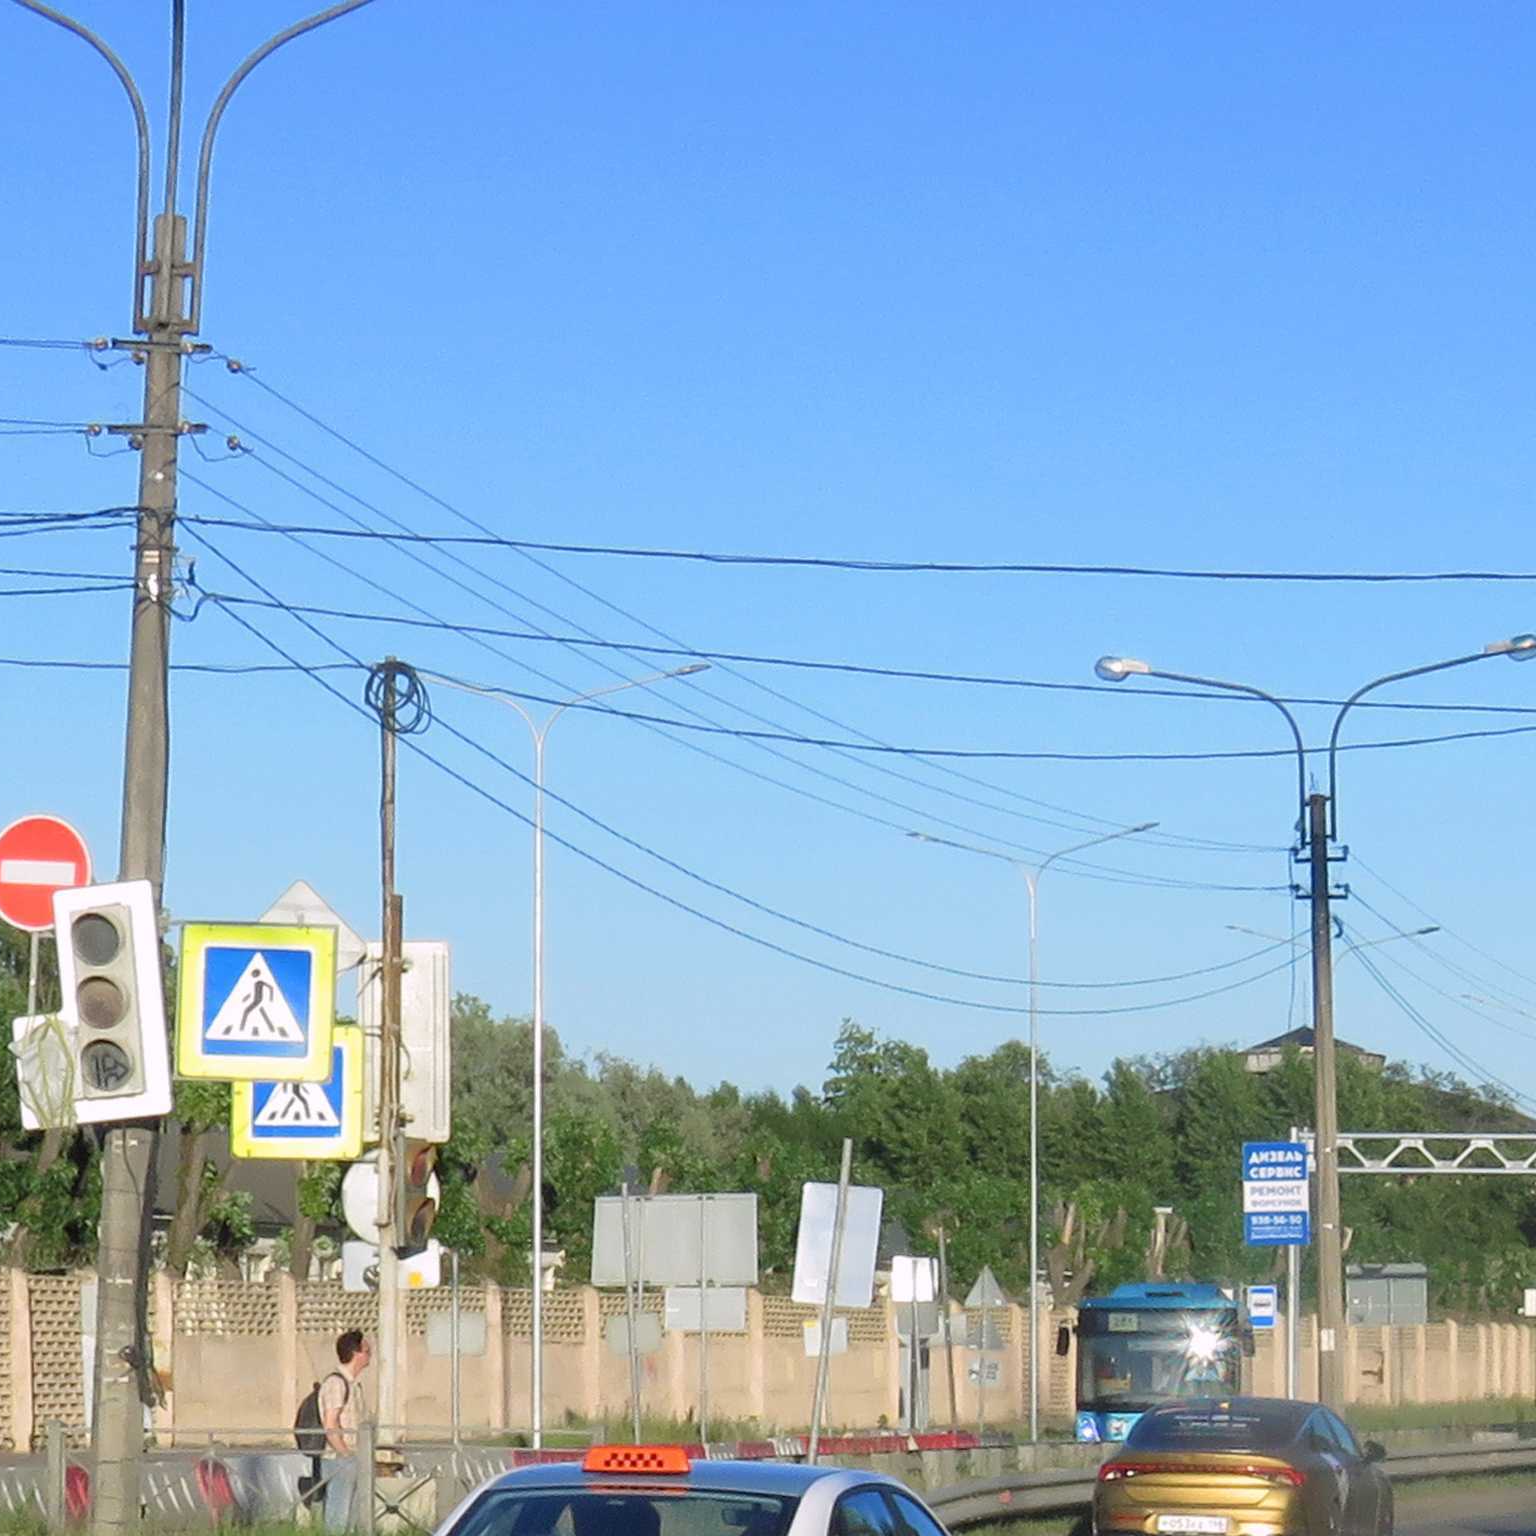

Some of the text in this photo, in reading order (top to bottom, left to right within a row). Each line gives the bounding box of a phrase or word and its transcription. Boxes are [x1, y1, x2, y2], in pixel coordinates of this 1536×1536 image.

[1248, 1150, 1304, 1164] ДИЗЕЛЬ
[1249, 1166, 1303, 1178] СЕРВИС
[1250, 1186, 1302, 1196] РЕМОНТ
